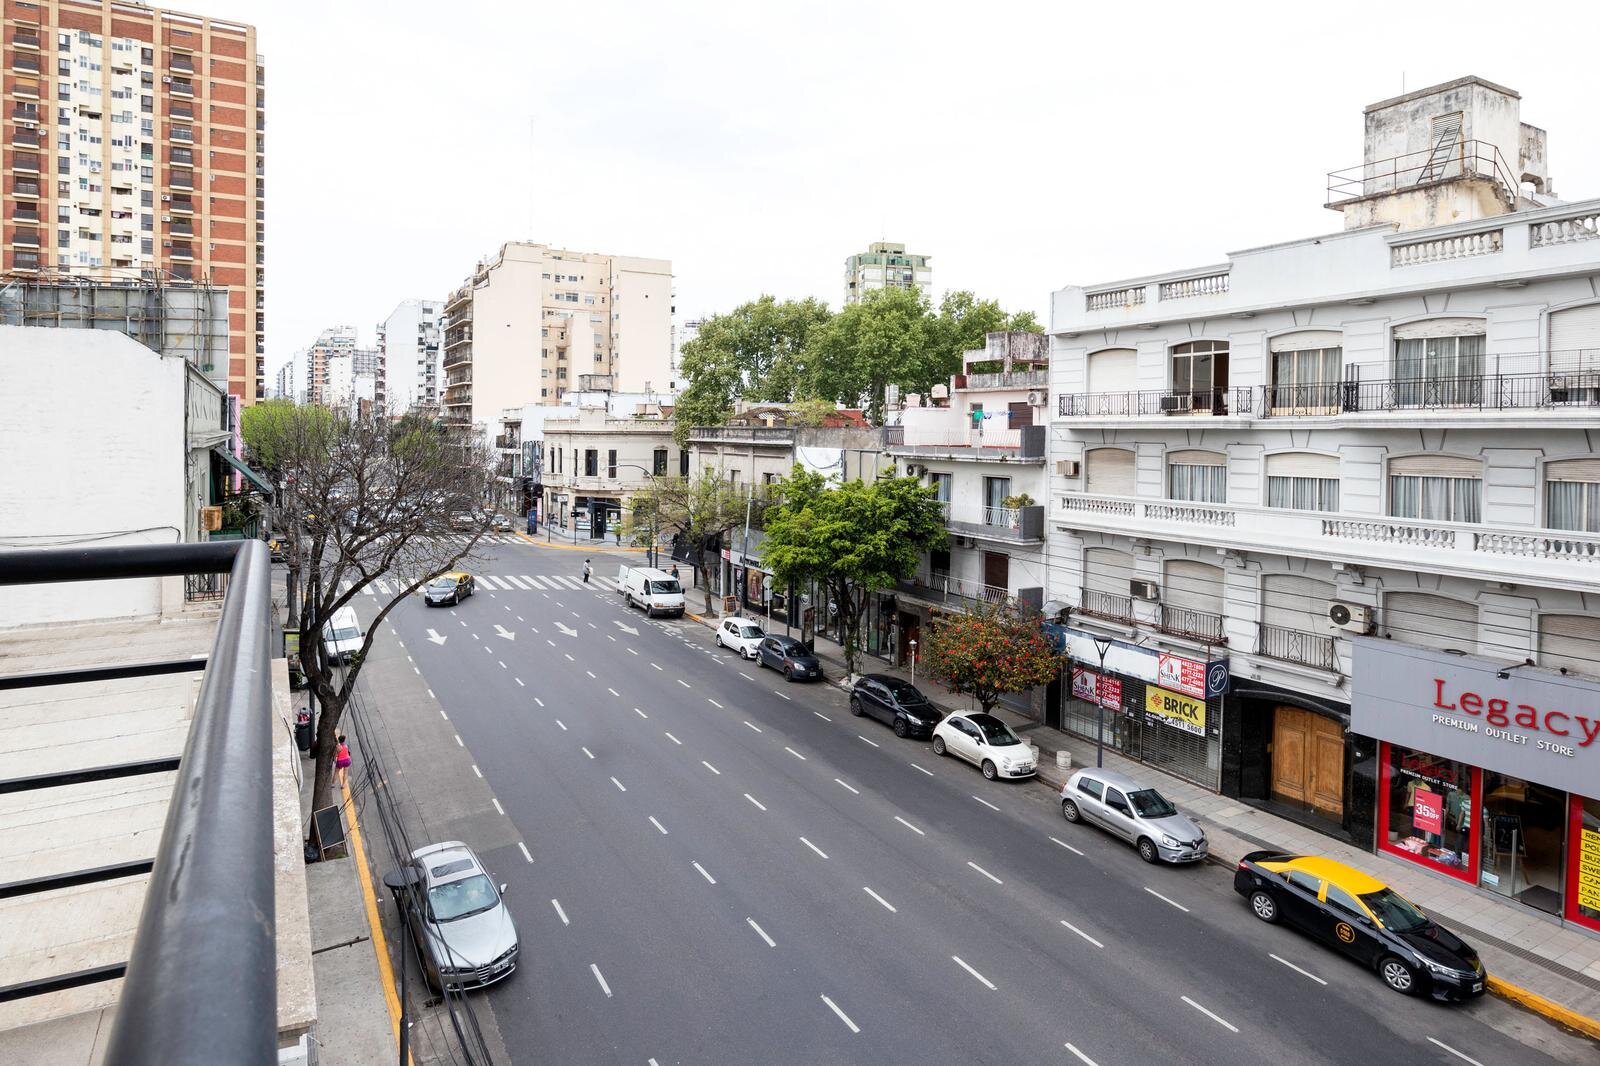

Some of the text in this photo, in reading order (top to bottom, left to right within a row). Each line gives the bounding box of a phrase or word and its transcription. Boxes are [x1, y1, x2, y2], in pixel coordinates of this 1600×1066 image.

[1164, 697, 1199, 720] BRICK
[1433, 678, 1600, 747] Legacy
[1432, 714, 1575, 757] PREMIUM OUTLET STORE
[1400, 768, 1459, 791] PREMIUM OUTLET STORE
